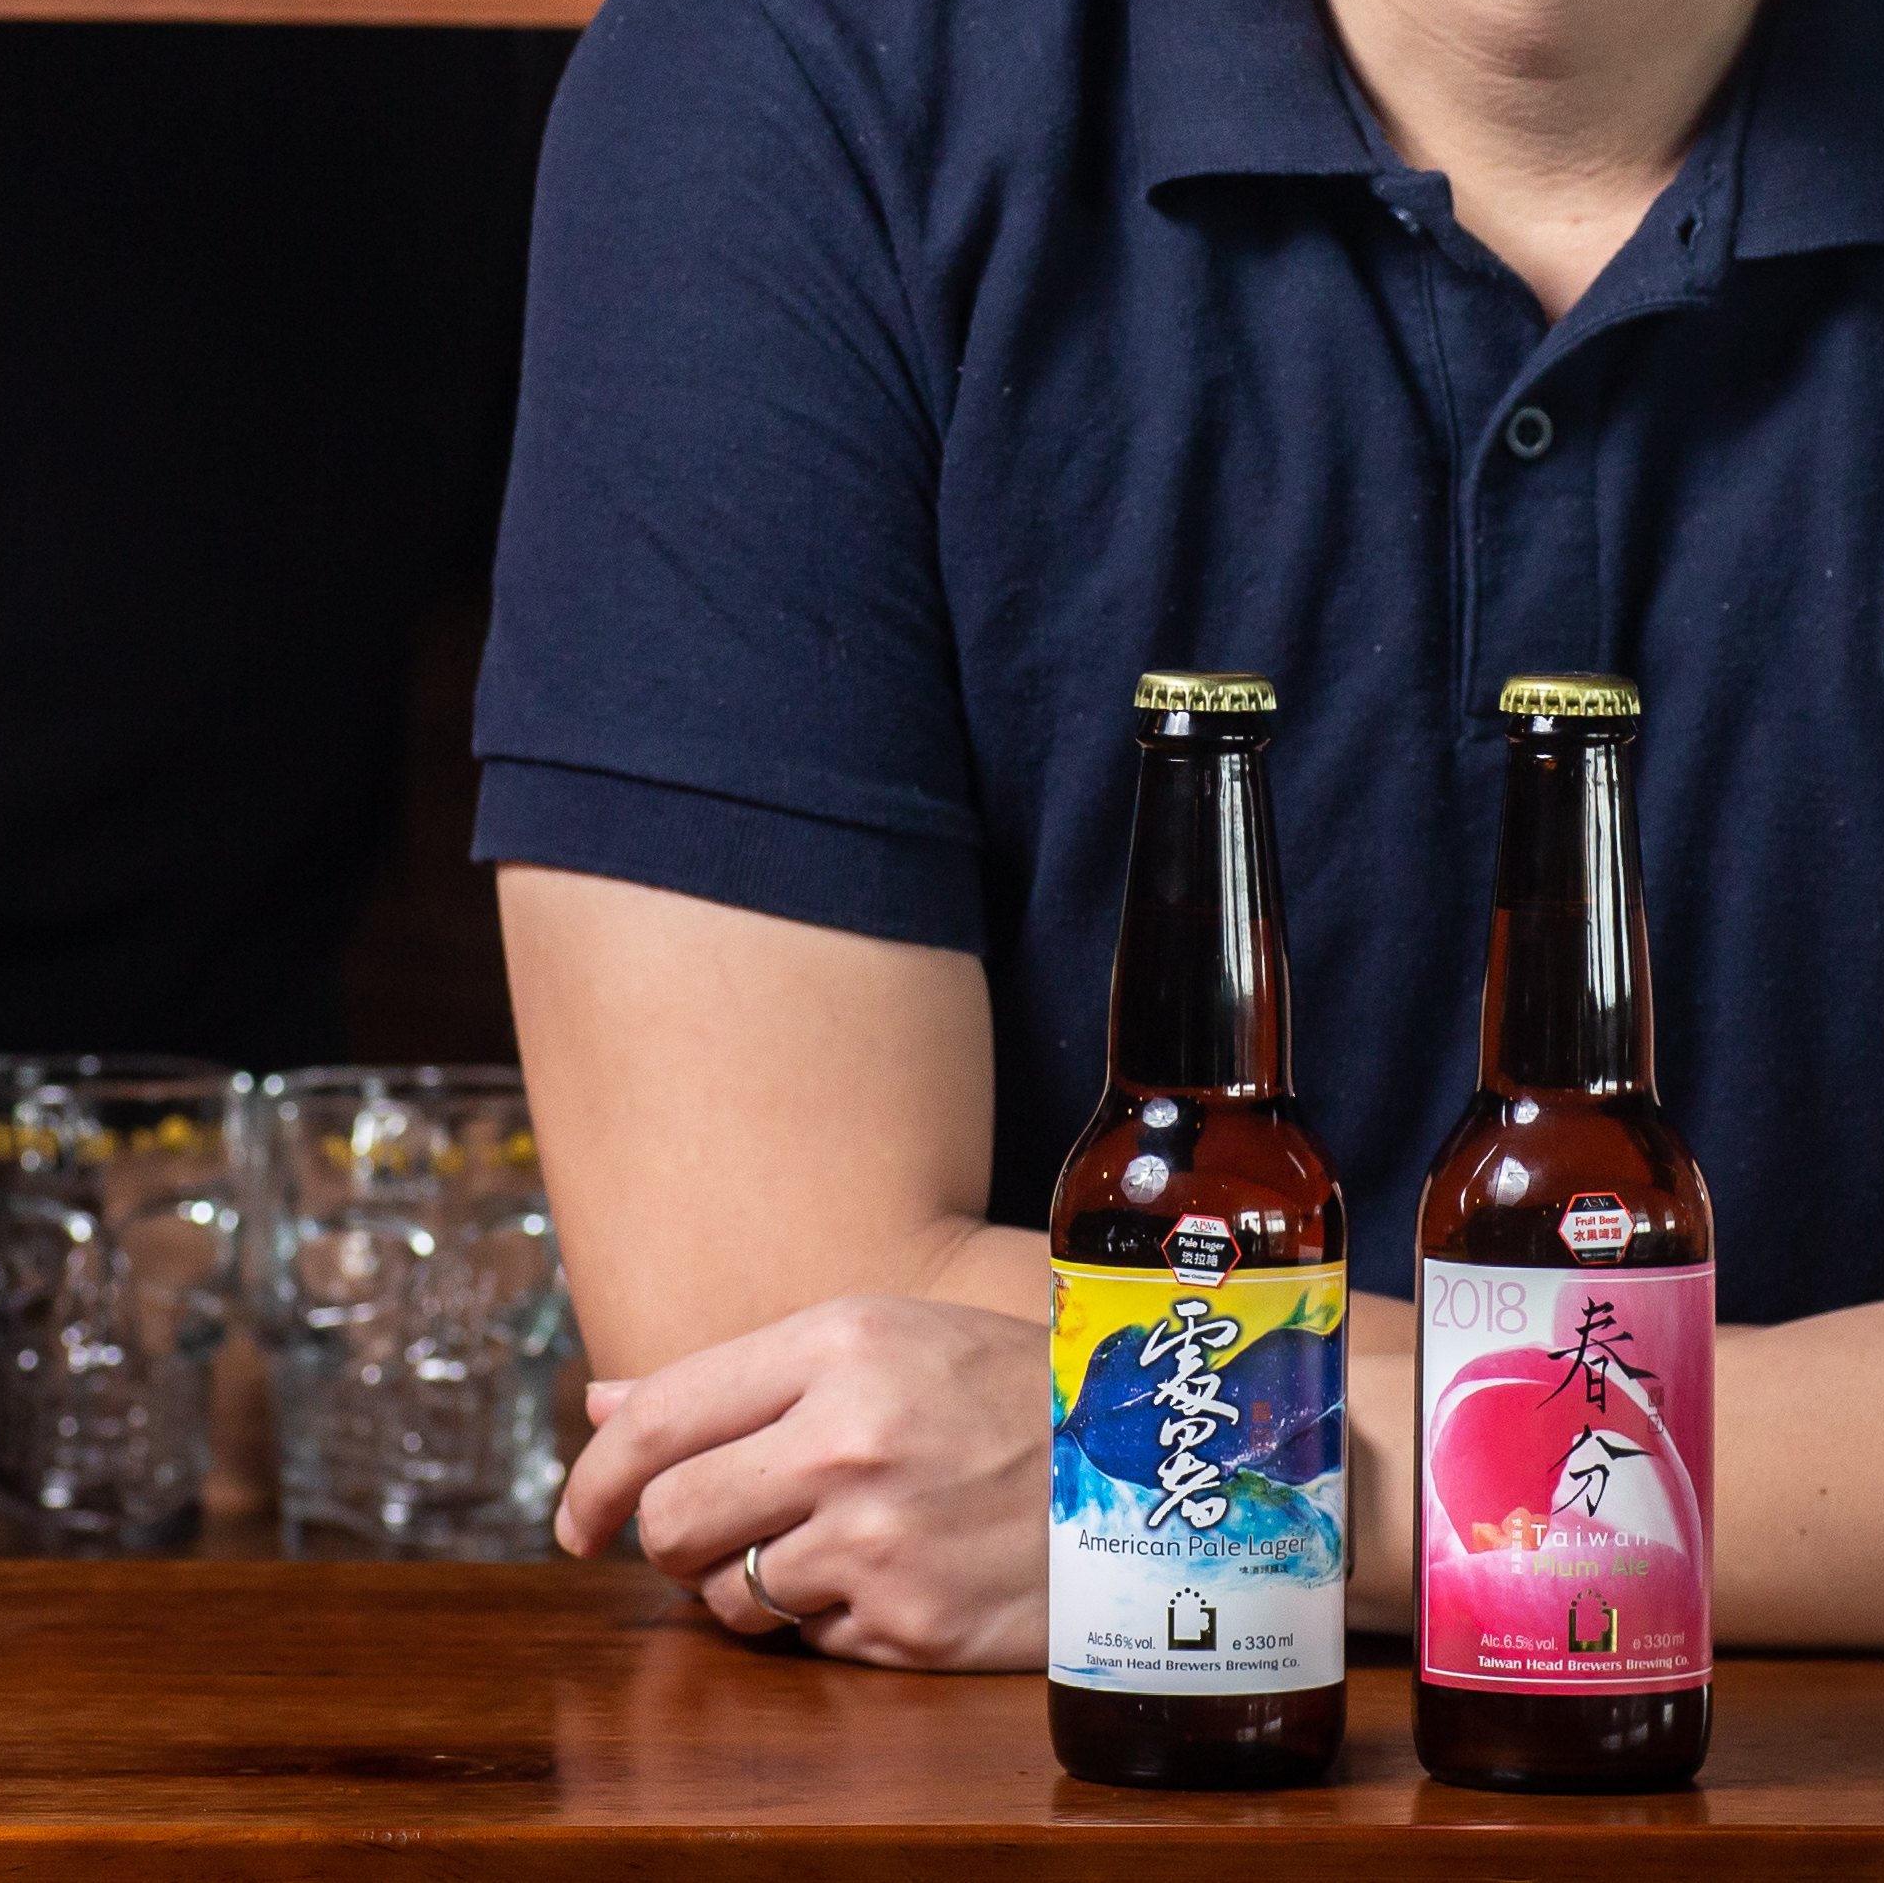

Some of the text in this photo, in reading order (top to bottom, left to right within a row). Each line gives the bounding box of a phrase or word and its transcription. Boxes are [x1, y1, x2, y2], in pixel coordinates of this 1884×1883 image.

[1575, 1215, 1620, 1226] Fruit Beer
[1178, 1236, 1226, 1252] Pale Lager
[1432, 1274, 1528, 1335] 2018
[1534, 1296, 1661, 1518] 春分
[1530, 1523, 1650, 1548] Taiwan
[1078, 1528, 1307, 1561] American Pale Lager
[1533, 1554, 1649, 1577] Plum Ale
[1135, 1636, 1156, 1650] vol.
[1245, 1634, 1276, 1650] 330
[1278, 1633, 1294, 1648] ml
[1535, 1636, 1558, 1651] vol.
[1644, 1633, 1671, 1648] 330
[1672, 1632, 1685, 1646] ml
[1085, 1654, 1301, 1671] Taiwan Head Brewers Brewing Co.
[1478, 1655, 1689, 1671] Taiwan Head Brewers Brewing Co.
